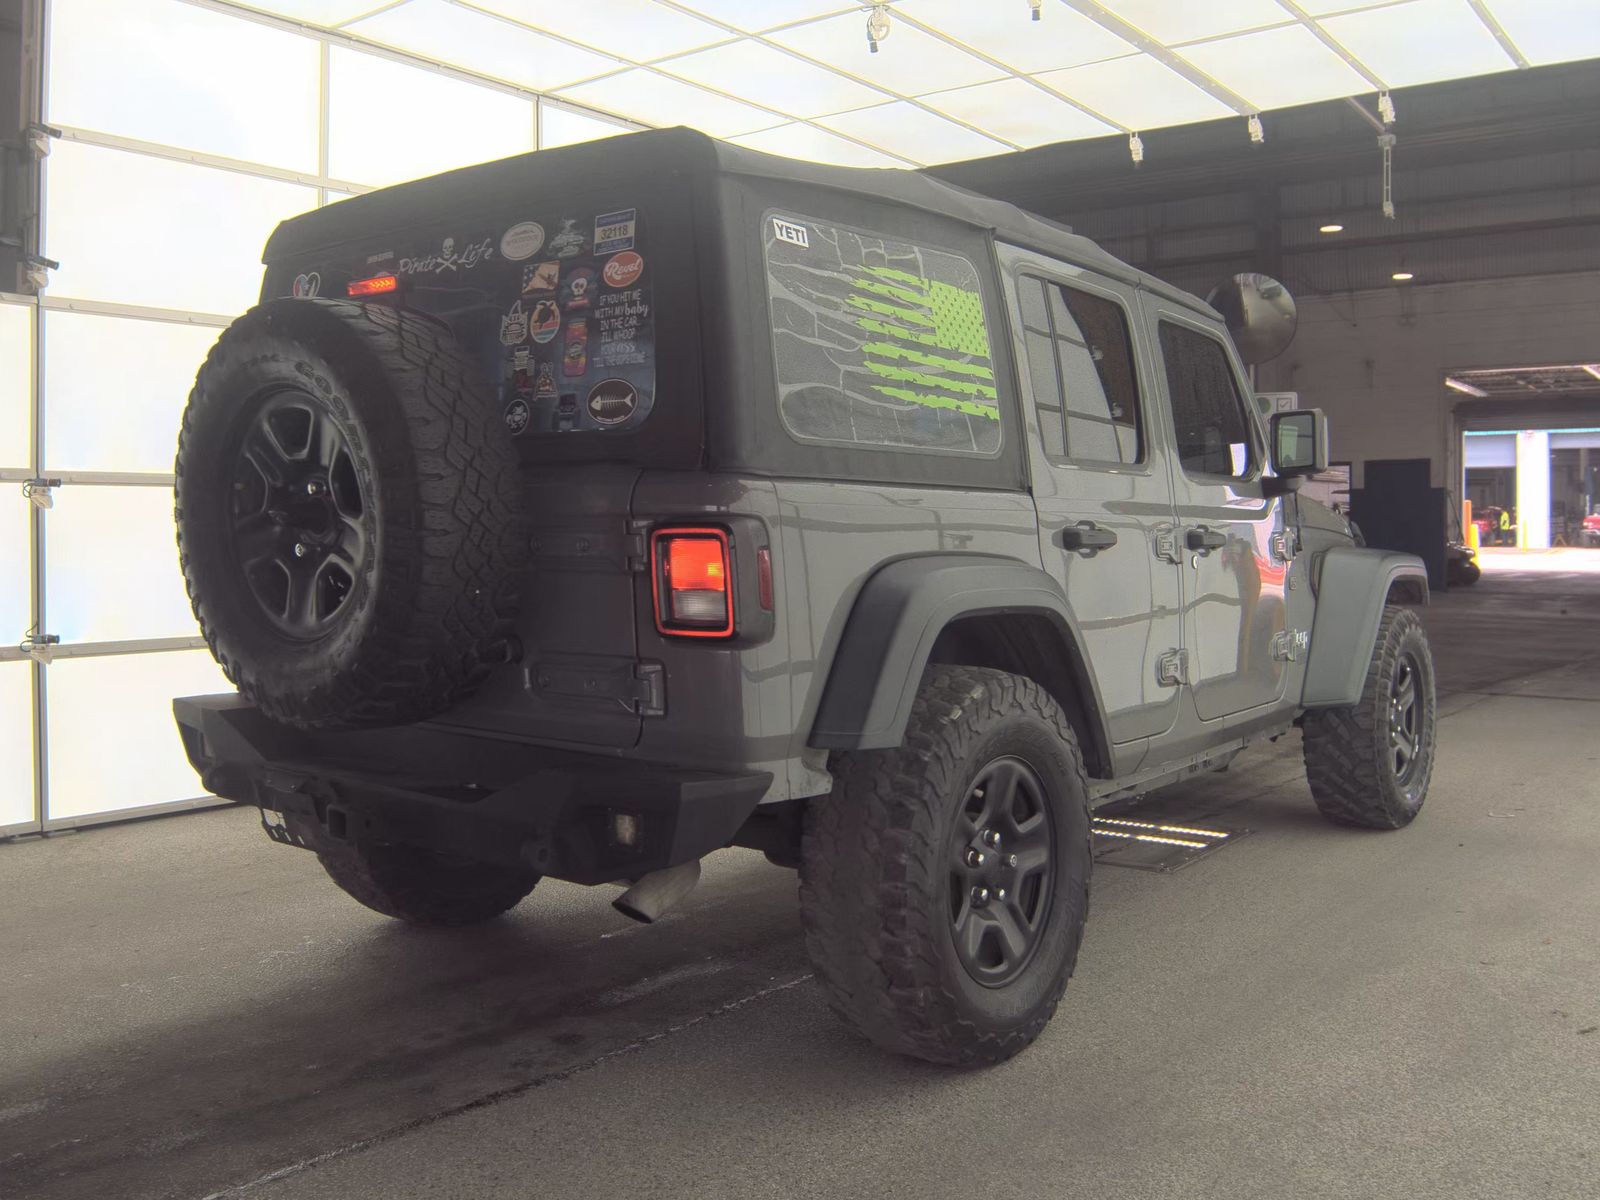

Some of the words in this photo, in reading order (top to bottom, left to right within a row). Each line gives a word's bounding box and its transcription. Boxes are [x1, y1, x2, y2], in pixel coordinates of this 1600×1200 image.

[601, 225, 628, 240] 32118
[775, 222, 806, 244] YETI
[399, 256, 436, 274] Pirate
[457, 238, 493, 268] Life
[625, 300, 648, 317] baby
